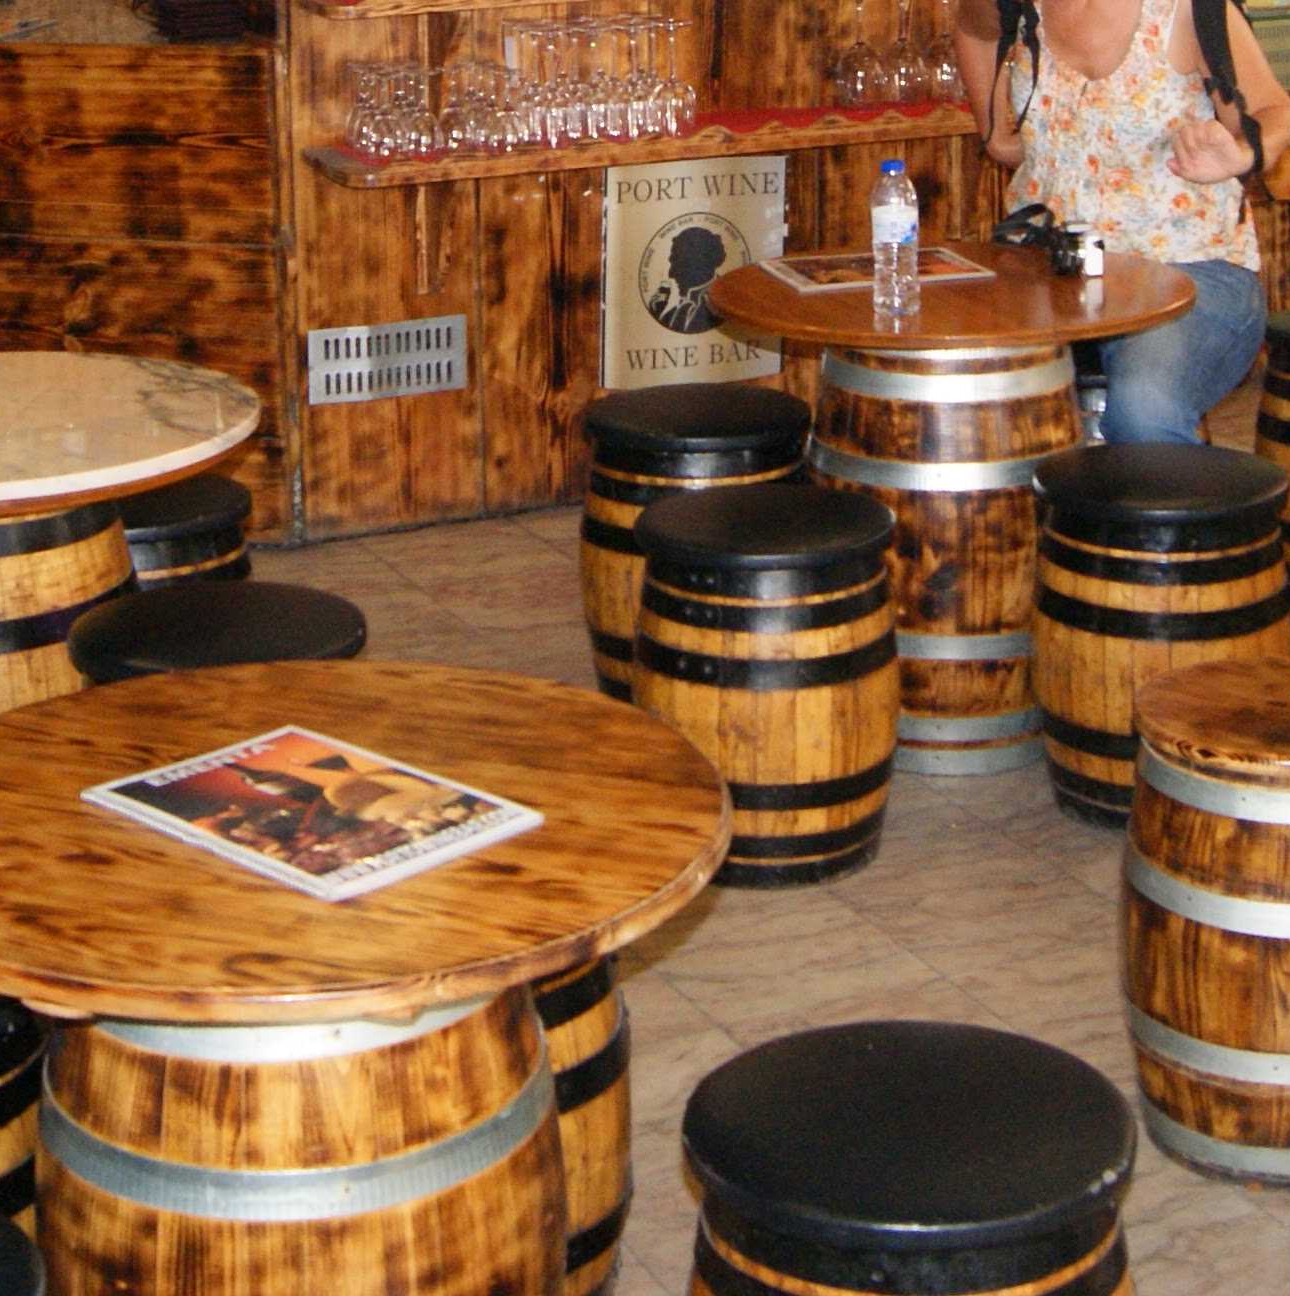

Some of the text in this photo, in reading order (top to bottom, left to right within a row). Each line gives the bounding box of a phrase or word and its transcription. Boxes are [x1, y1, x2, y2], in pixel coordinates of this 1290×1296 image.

[616, 172, 779, 204] PORT WINE
[627, 340, 761, 371] WINE BAR
